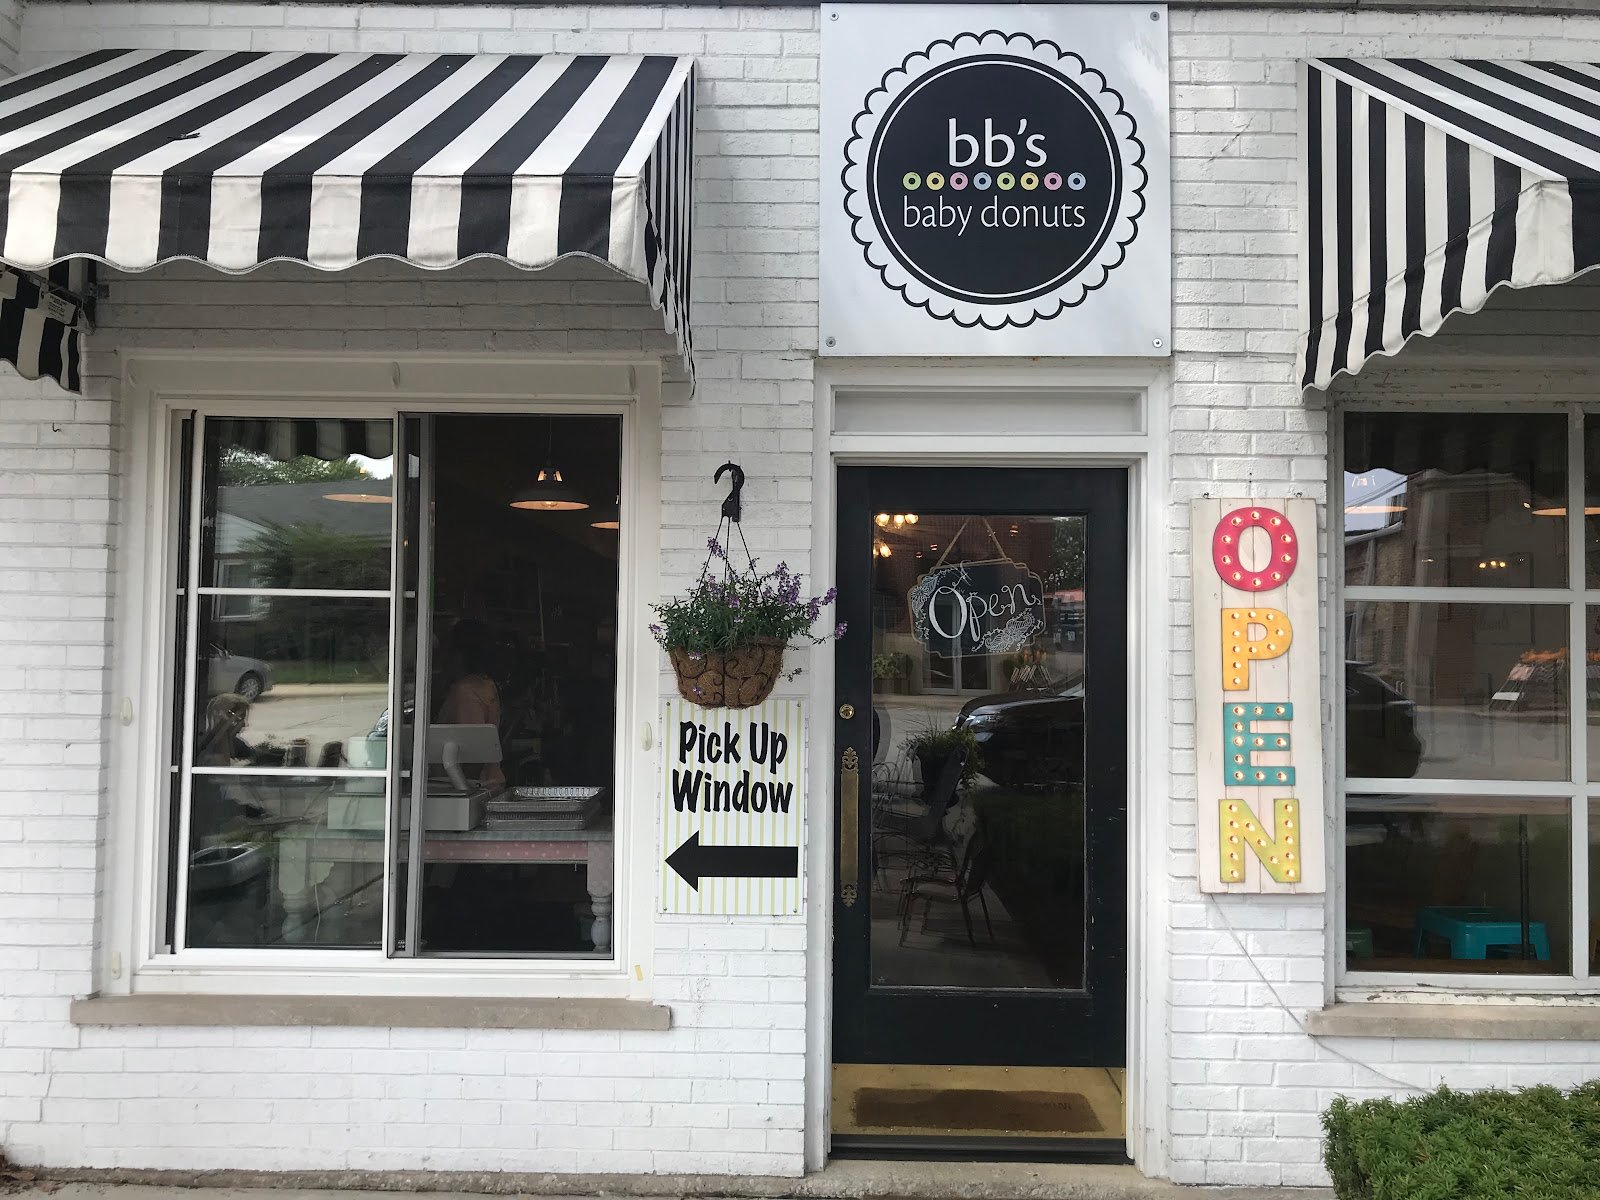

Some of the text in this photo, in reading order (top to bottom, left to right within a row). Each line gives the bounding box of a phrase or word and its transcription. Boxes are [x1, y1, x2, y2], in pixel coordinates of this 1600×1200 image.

[948, 117, 1048, 167] bb’s
[903, 195, 1086, 236] baby donuts
[928, 583, 1042, 642] Open
[1212, 506, 1301, 883] OPEN
[679, 720, 788, 774] Pick Up
[672, 768, 794, 814] Window
